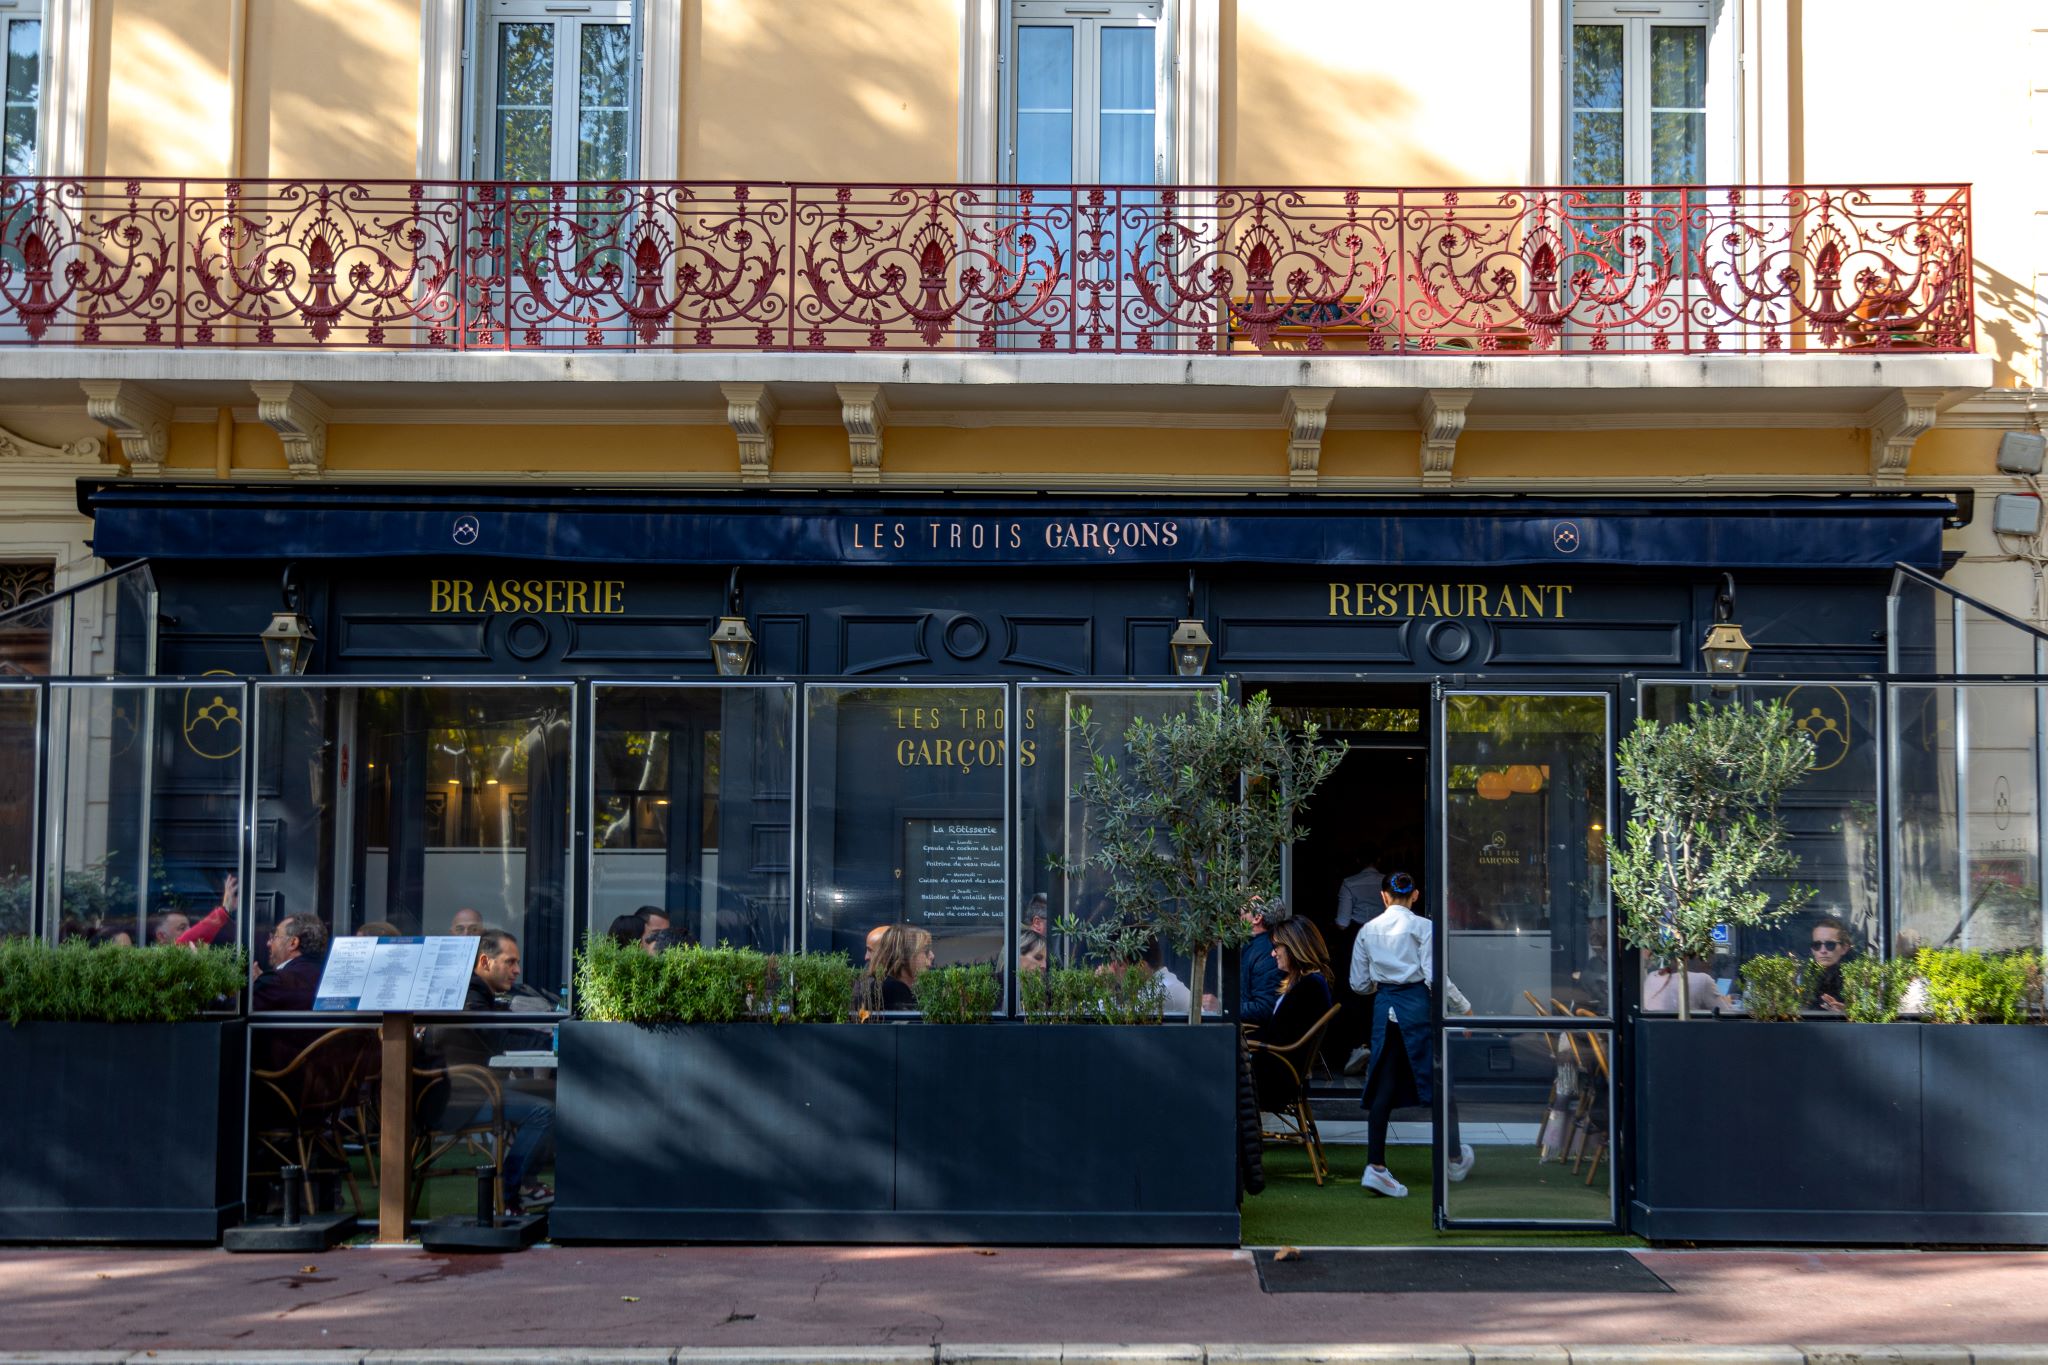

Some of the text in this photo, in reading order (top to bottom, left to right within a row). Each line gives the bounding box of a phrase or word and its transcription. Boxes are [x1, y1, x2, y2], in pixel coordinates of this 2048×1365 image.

[854, 522, 1178, 554] LES TROIS GARÇONS
[430, 579, 625, 614] BRASSERIE
[1328, 583, 1573, 618] RESTAURANT
[898, 708, 1035, 729] LES TROS
[933, 825, 944, 833] La
